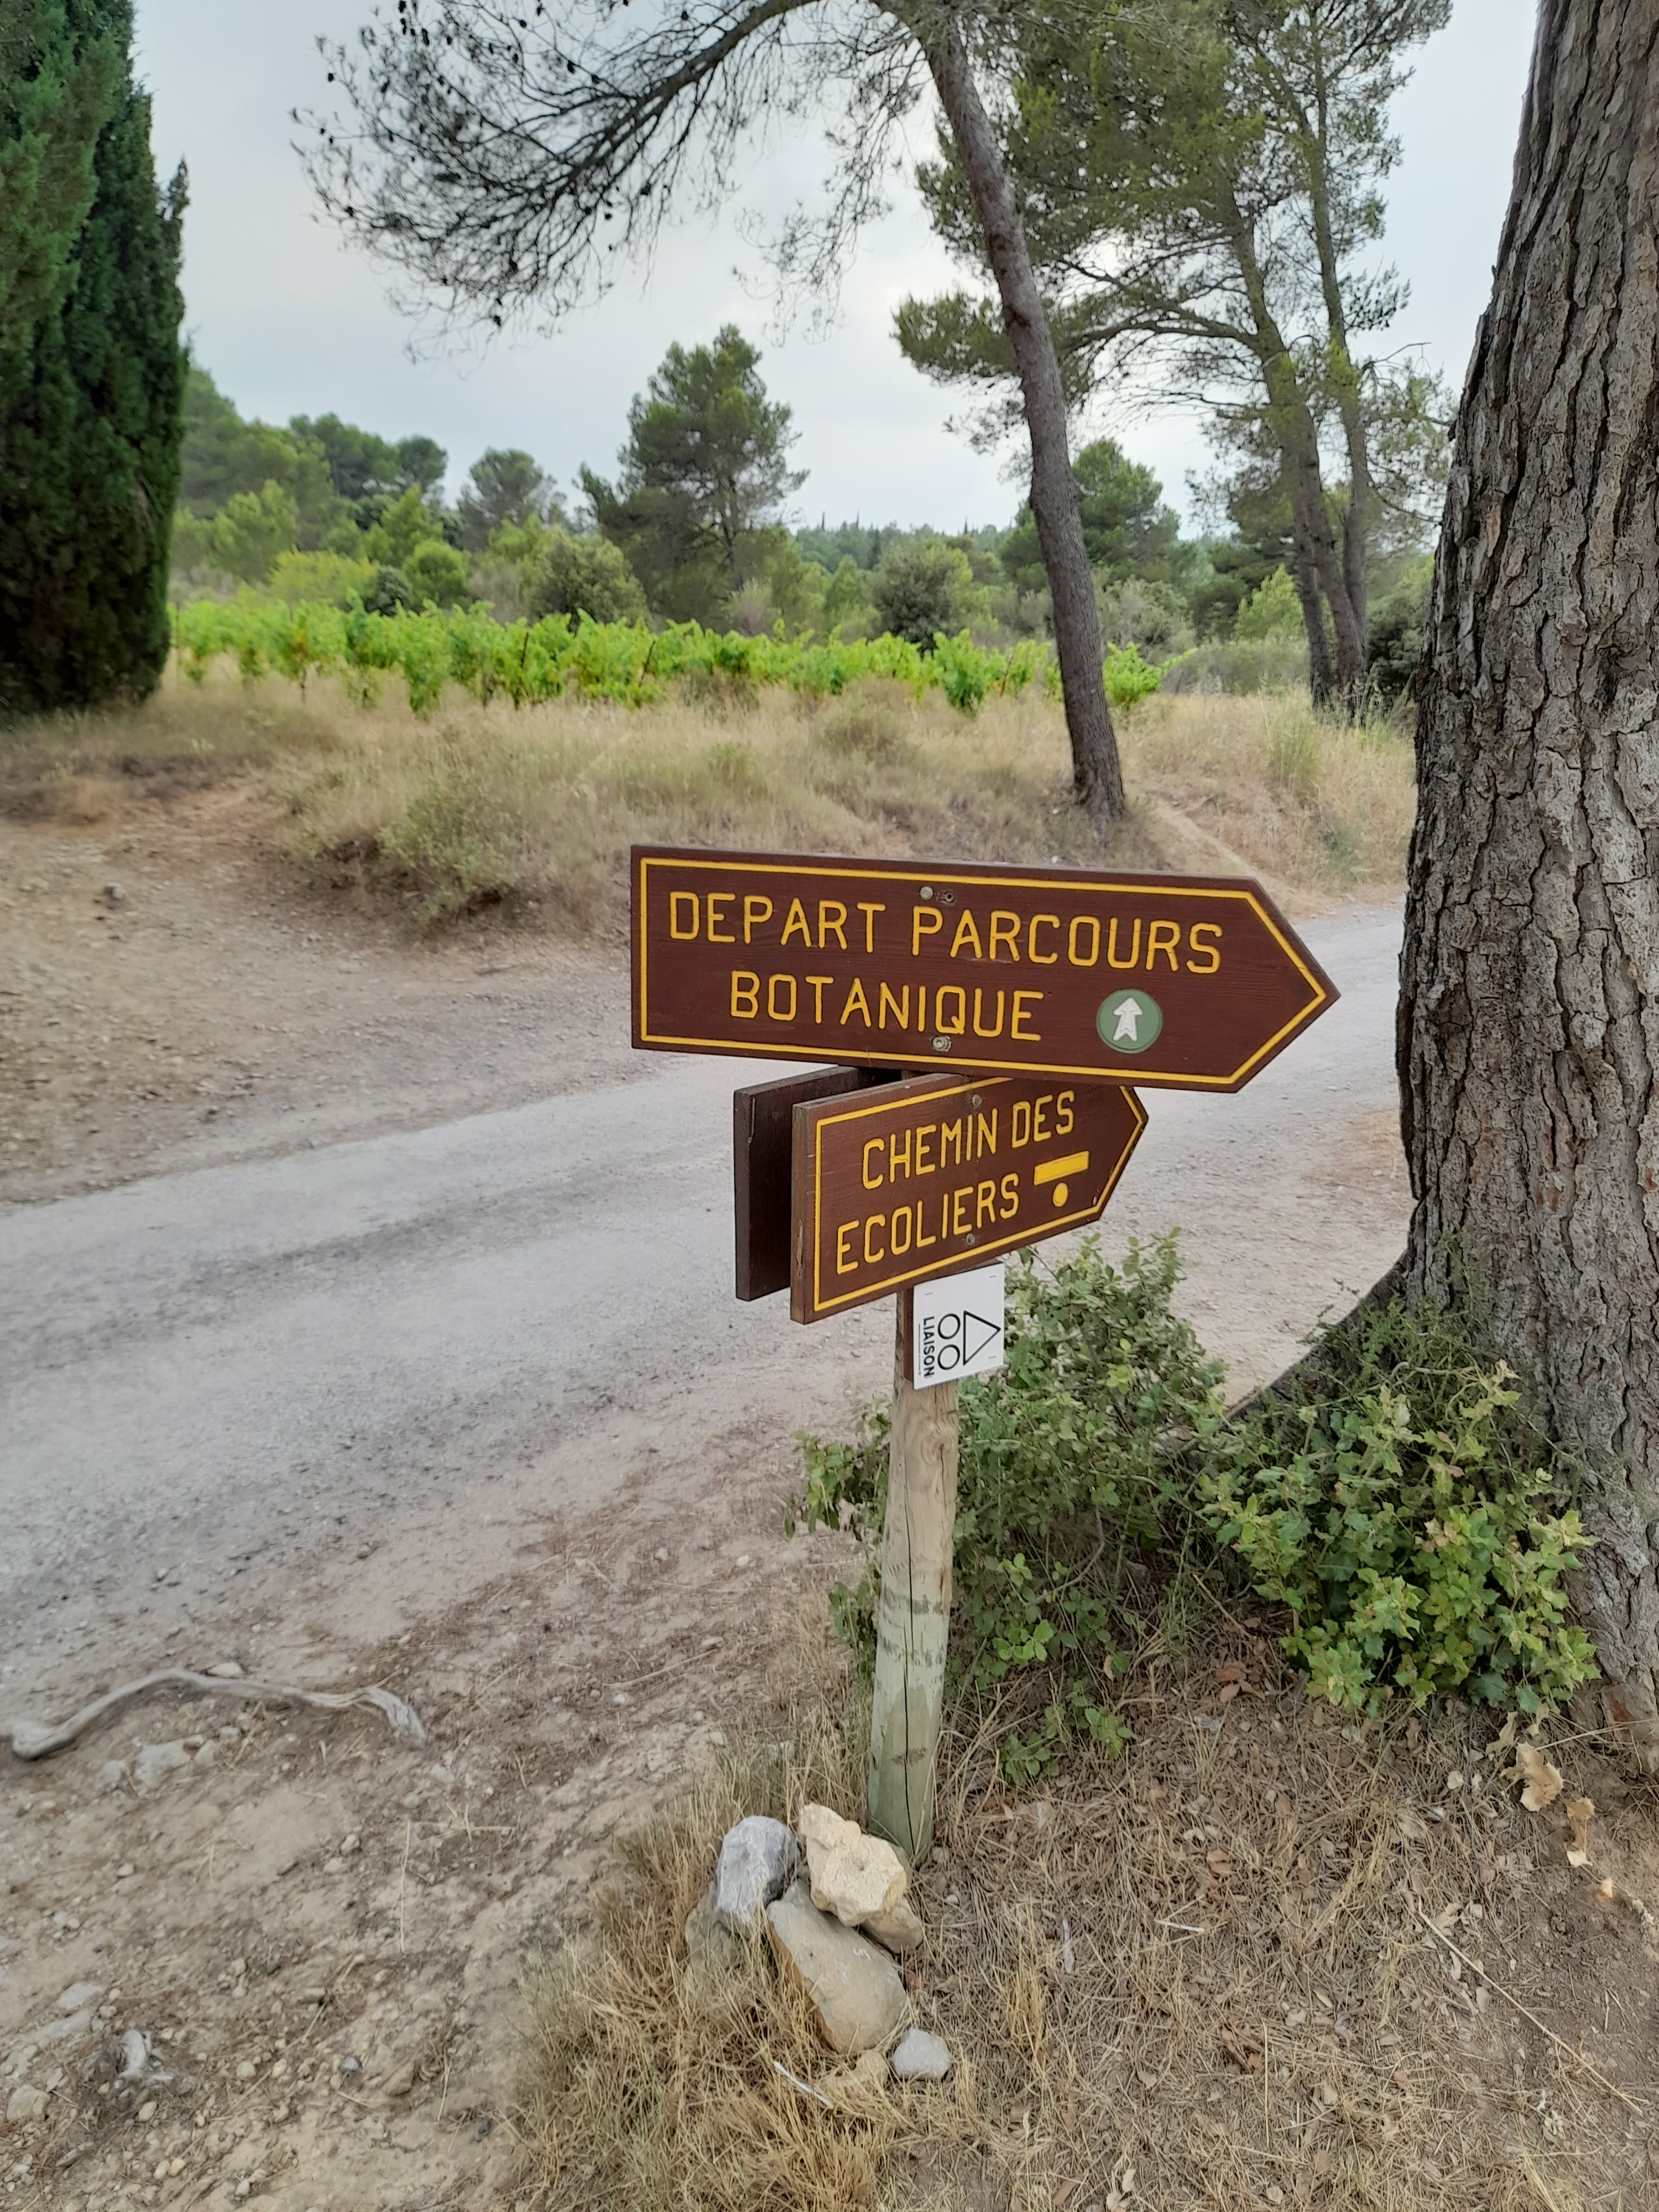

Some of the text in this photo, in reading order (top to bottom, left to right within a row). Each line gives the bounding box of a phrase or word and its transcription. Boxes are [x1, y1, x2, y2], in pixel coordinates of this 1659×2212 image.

[669, 891, 1223, 974] DEPART PARCOURS
[730, 969, 1045, 1041] BOTANIQUE
[862, 1089, 1076, 1190] CHEMIN DES
[836, 1172, 1020, 1275] ECOLIERS
[923, 1316, 935, 1378] LIAISON
